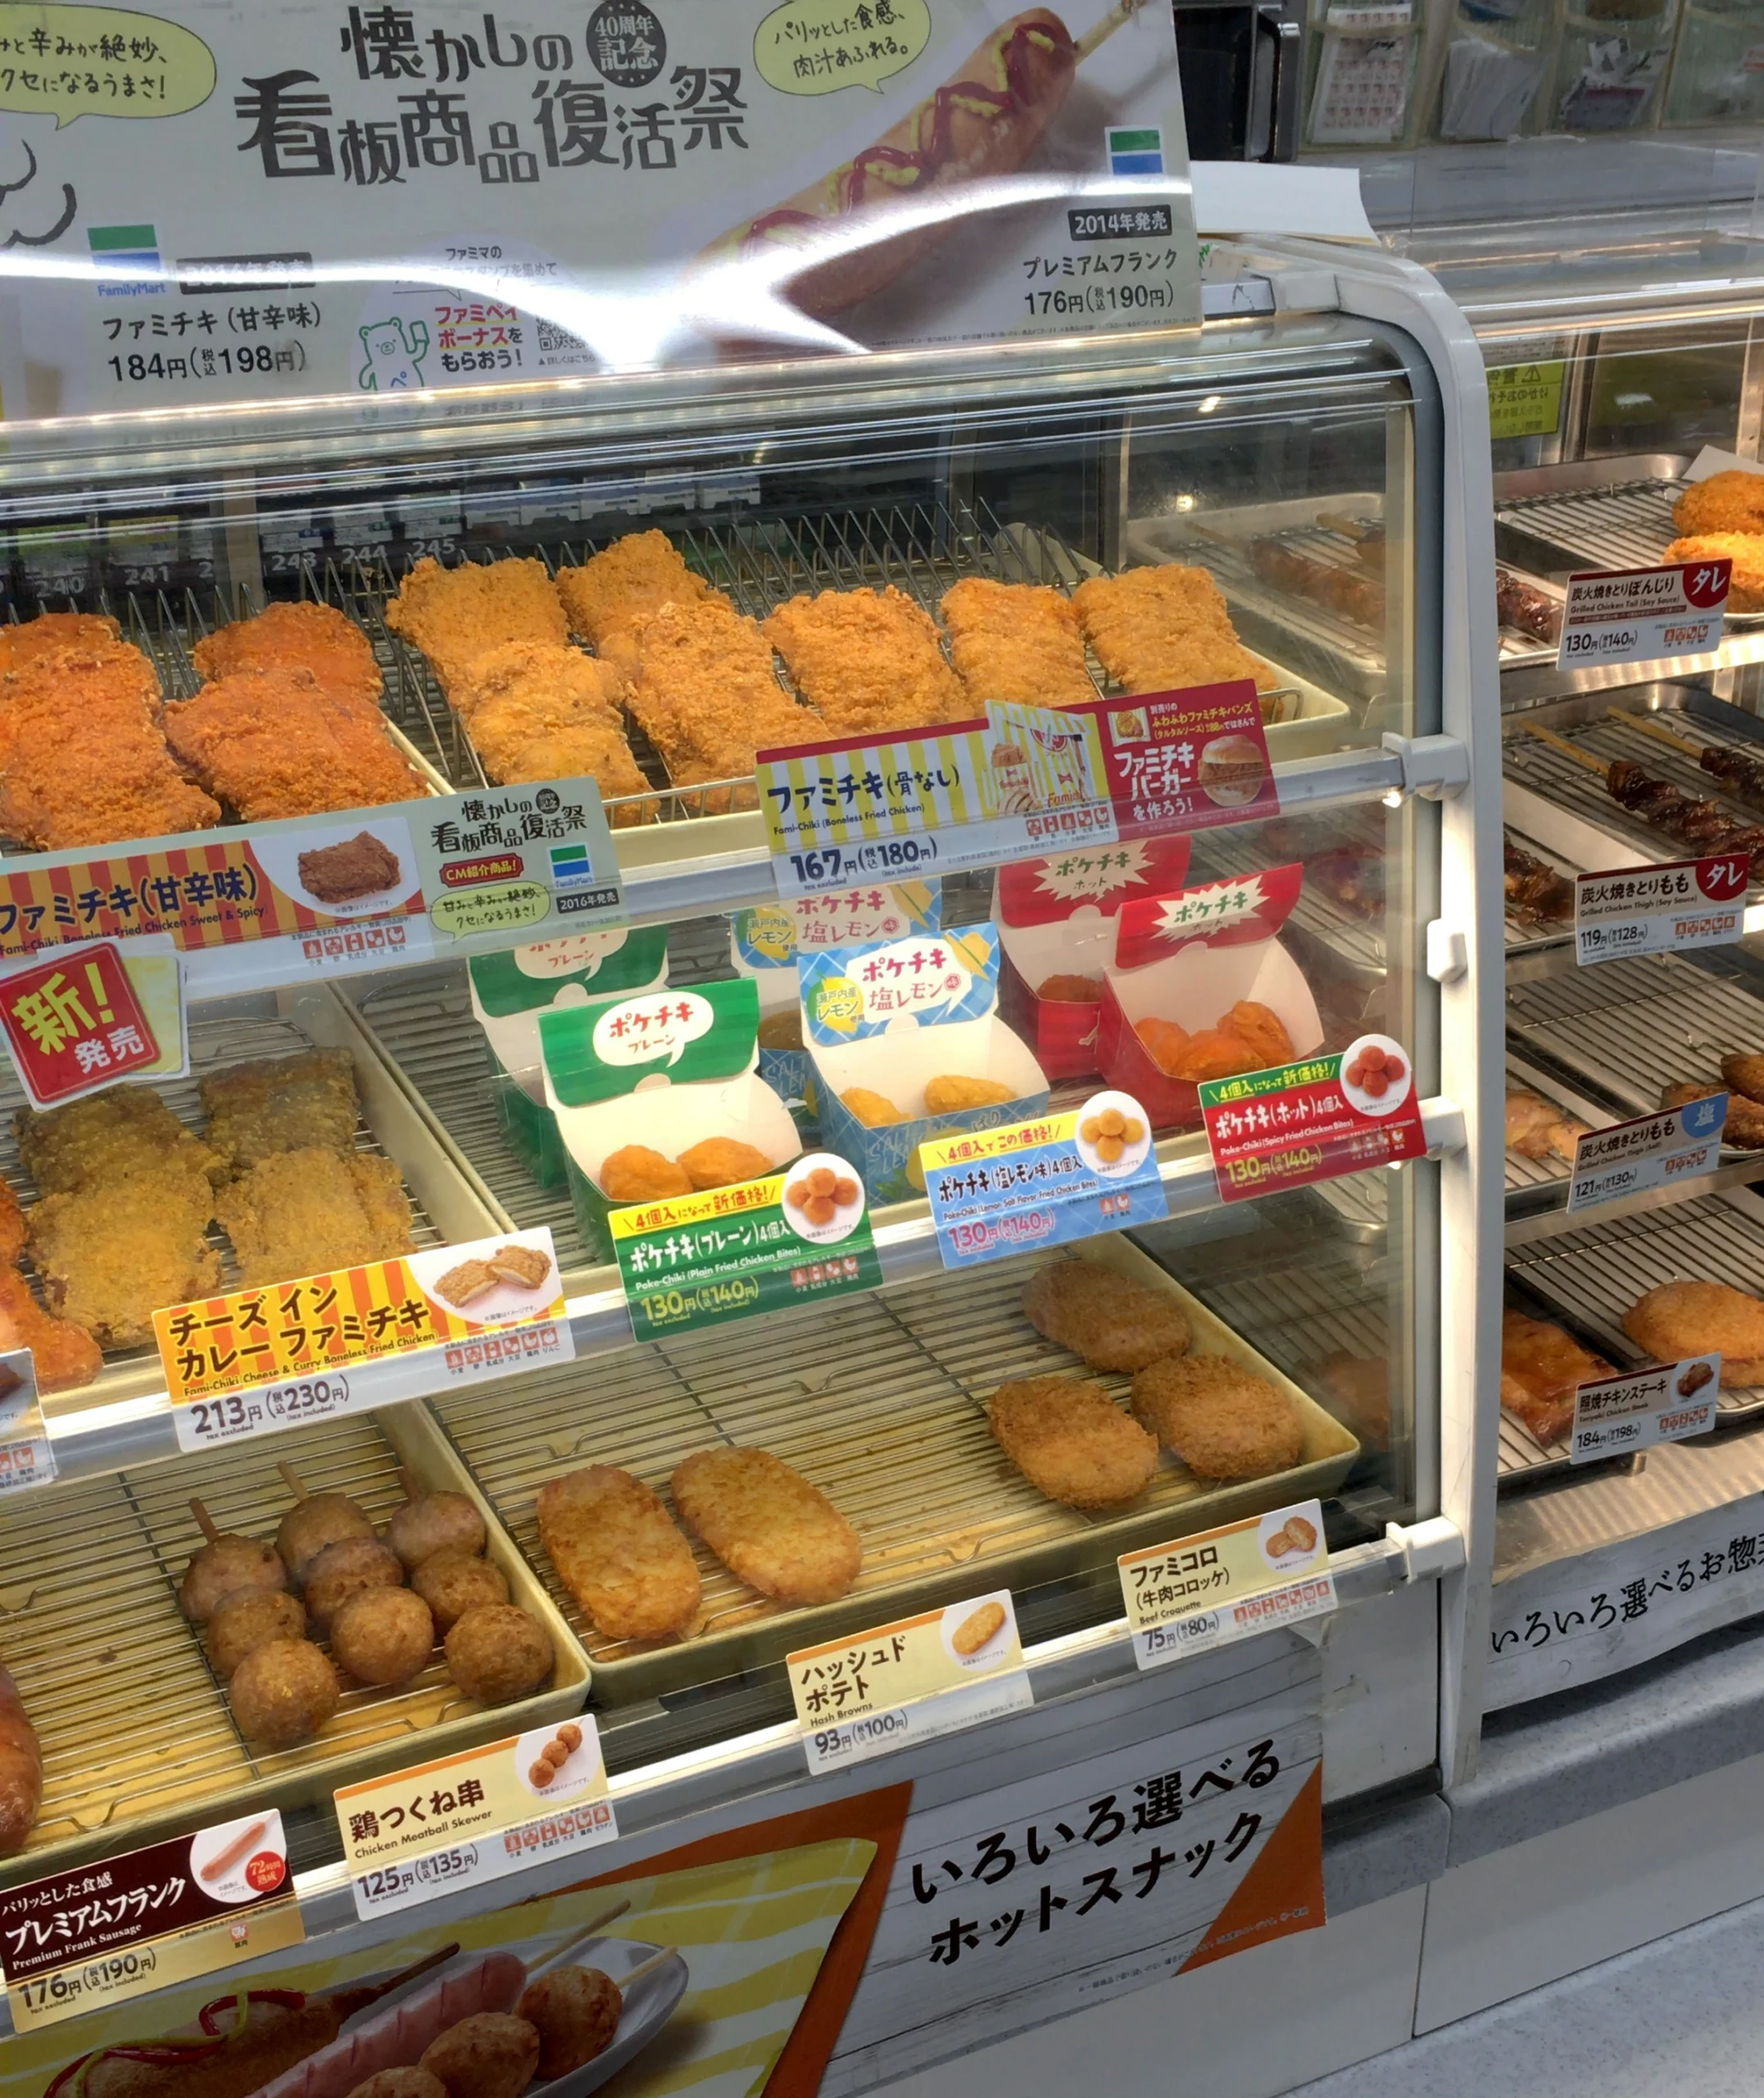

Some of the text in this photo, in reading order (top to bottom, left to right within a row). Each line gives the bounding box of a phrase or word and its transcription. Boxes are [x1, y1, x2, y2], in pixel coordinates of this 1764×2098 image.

[596, 14, 654, 38] 40周年
[341, 5, 573, 82] 懐かしの
[598, 38, 659, 72] 記念
[793, 36, 909, 78] 肉汁あふれる。
[234, 65, 748, 185] 看板商品復活祭
[1074, 211, 1168, 234] 2014年発売
[446, 245, 502, 261] ファミマの
[1023, 248, 1177, 279] プレミアムフランク
[97, 283, 166, 297] FamilyMart
[438, 326, 524, 349] ボーナスを
[442, 349, 523, 372] もらおう!
[1691, 566, 1727, 596] タレ
[1597, 602, 1623, 611] Chicken
[1114, 742, 1195, 777] ファミチキ
[767, 764, 961, 814] ファミチキ(骨なし)
[1131, 768, 1191, 802] バーガー
[461, 797, 533, 823] 懐かしの
[773, 802, 925, 835] Fami-Chiki (Boneless Fried Chicken)
[1133, 797, 1195, 821] を作ろう!
[431, 804, 587, 854] 看板商品復活祭
[446, 861, 517, 881] CM紹介商品!
[1055, 850, 1131, 878] ポケチキ
[1706, 861, 1744, 890] タレ
[1072, 876, 1108, 890] ホット
[1580, 873, 1689, 906] 炭火焼きとりもも
[560, 892, 617, 910] 2016年発売
[1173, 890, 1249, 924] ポケチキ
[1605, 903, 1633, 913] Chicken
[1635, 900, 1655, 910] Thigh
[145, 919, 187, 933] Chicken
[189, 912, 222, 926] Sweet
[225, 910, 234, 920] &
[747, 918, 790, 928] 瀬戸内産
[748, 929, 791, 944] レモン
[1189, 919, 1222, 933] ホット
[782, 943, 798, 952] 使用
[863, 947, 947, 982] ポケチキ
[11, 961, 116, 1056] 新!
[610, 1002, 695, 1038] ポケチキ
[817, 1001, 859, 1021] レモン
[75, 1024, 144, 1074] 発売
[1694, 1103, 1716, 1128] 塩
[1040, 1189, 1055, 1199] Fried
[1057, 1183, 1080, 1196] Chicken
[636, 1272, 686, 1292] Poke-Chiki
[687, 1267, 714, 1280] (Plain
[715, 1261, 738, 1274] Fried
[740, 1254, 775, 1268] Chicken
[777, 1246, 801, 1262] Bites)
[170, 1285, 338, 1346] チーズ イン
[177, 1299, 429, 1382] カレー ファミチキ
[184, 1377, 239, 1396] Fami-Chiki
[241, 1366, 279, 1384] (Cheese
[283, 1364, 292, 1374] &
[324, 1347, 368, 1365] Boneless
[370, 1342, 395, 1355] Fried
[397, 1331, 438, 1348] Chicken)
[221, 1423, 255, 1437] excluded
[1130, 1546, 1218, 1588] ファミコロ
[1136, 1567, 1230, 1611] (牛肉コロッケ)
[1491, 1533, 1764, 1653] いろいろ選べるお惣
[1139, 1601, 1202, 1626] Beef Croquette
[800, 1635, 906, 1685] ハッシュド
[805, 1674, 869, 1714] ポテト
[810, 1702, 873, 1728] Hash Browns
[348, 1778, 485, 1843] 鶏つくね串
[911, 1738, 1281, 1905] いろいろ選べる
[355, 1838, 398, 1860] Chicken
[401, 1821, 449, 1845] Meatball
[451, 1809, 492, 1828] Skewer
[2, 1871, 113, 1917] パリッとした食感
[929, 1812, 1263, 1966] ホットスナック
[5, 1877, 187, 1955] プレミアムフランク
[12, 1923, 143, 1971] Premium Frank Sausage
